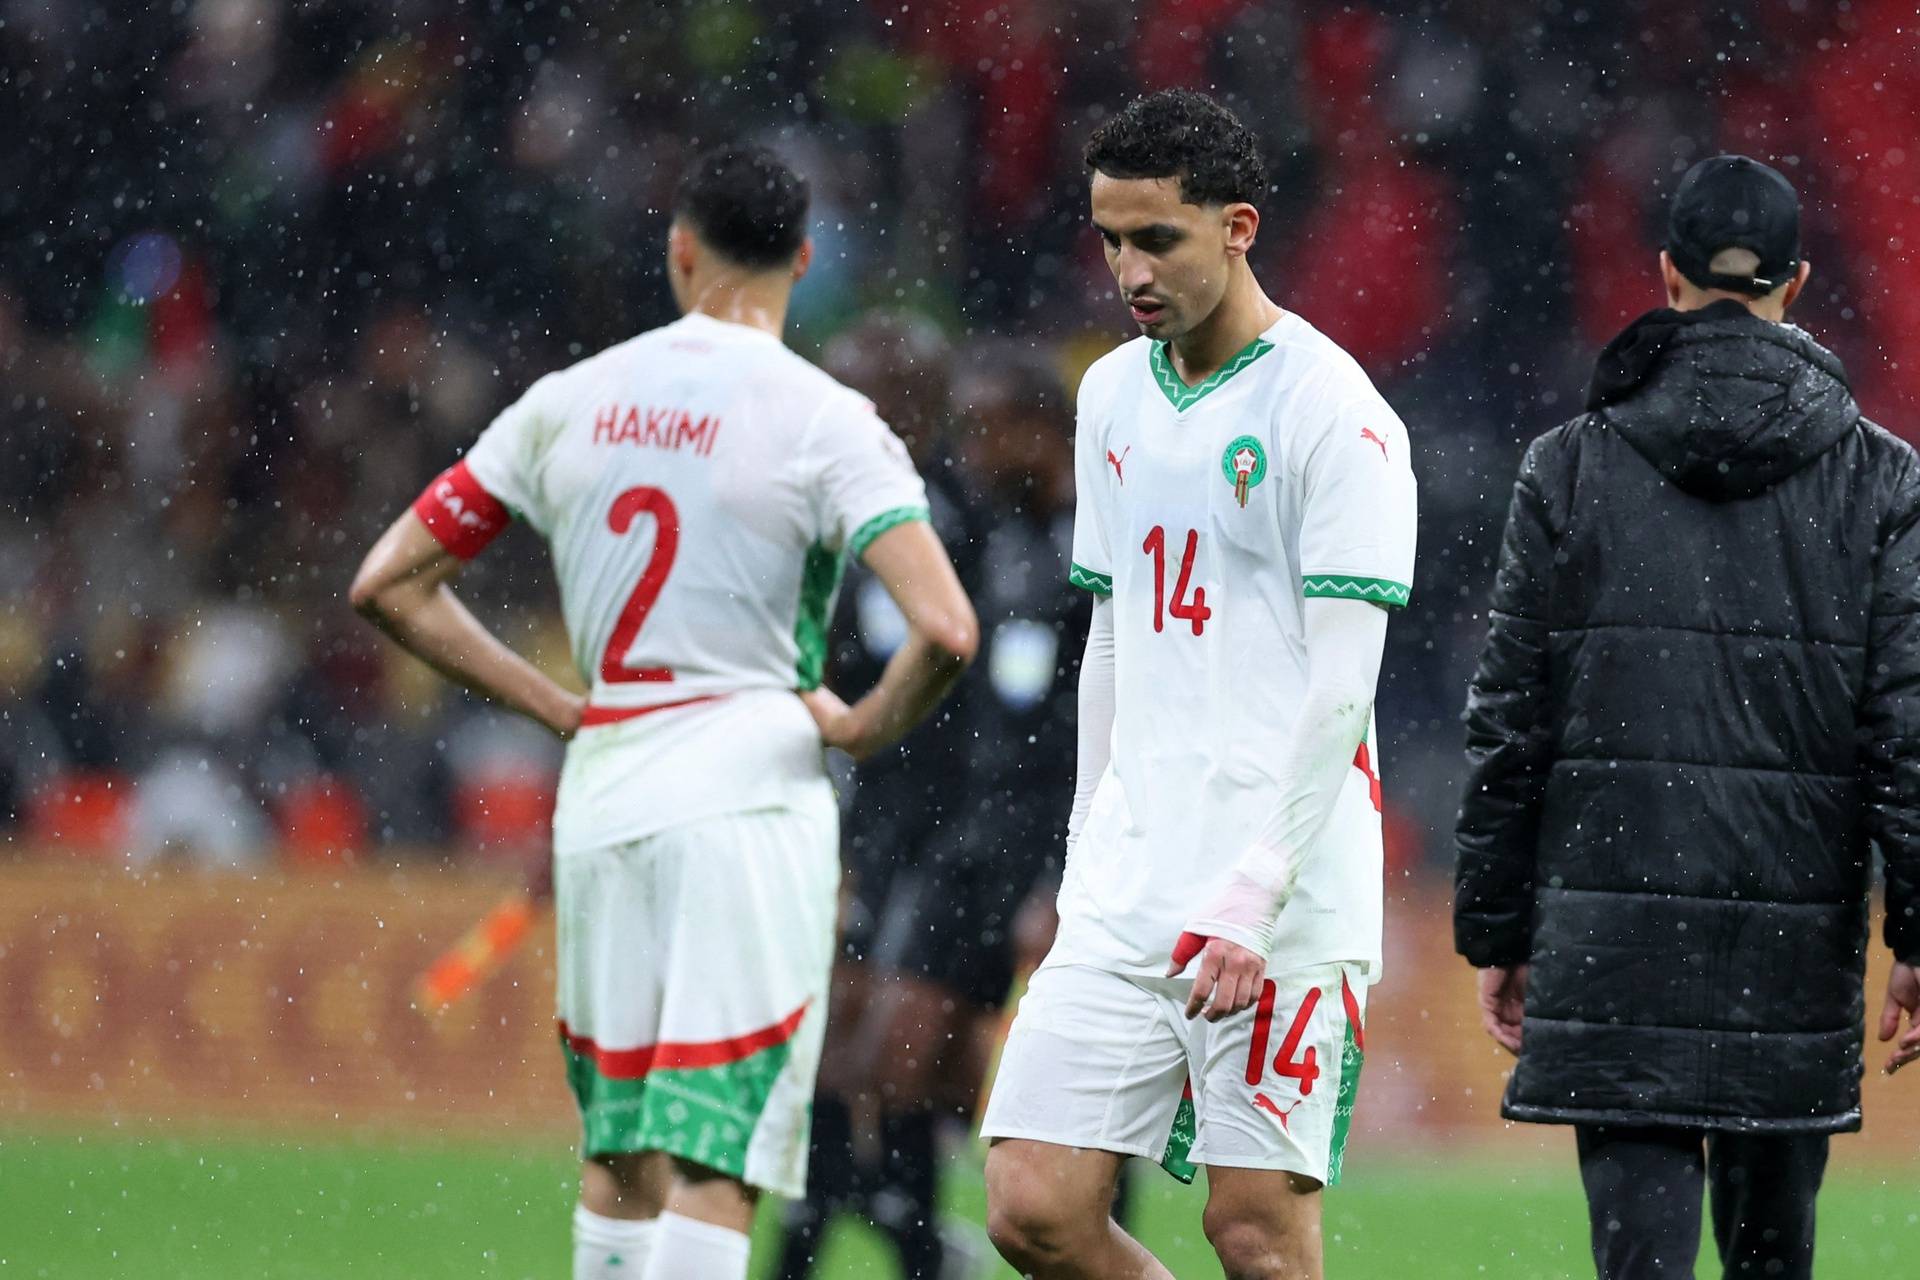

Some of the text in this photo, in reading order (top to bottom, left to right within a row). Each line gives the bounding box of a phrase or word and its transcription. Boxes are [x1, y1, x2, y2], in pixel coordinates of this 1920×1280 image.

[593, 402, 721, 457] HAKIMI
[601, 486, 679, 685] 2
[1143, 526, 1211, 636] 14
[1246, 979, 1321, 1096] 14
